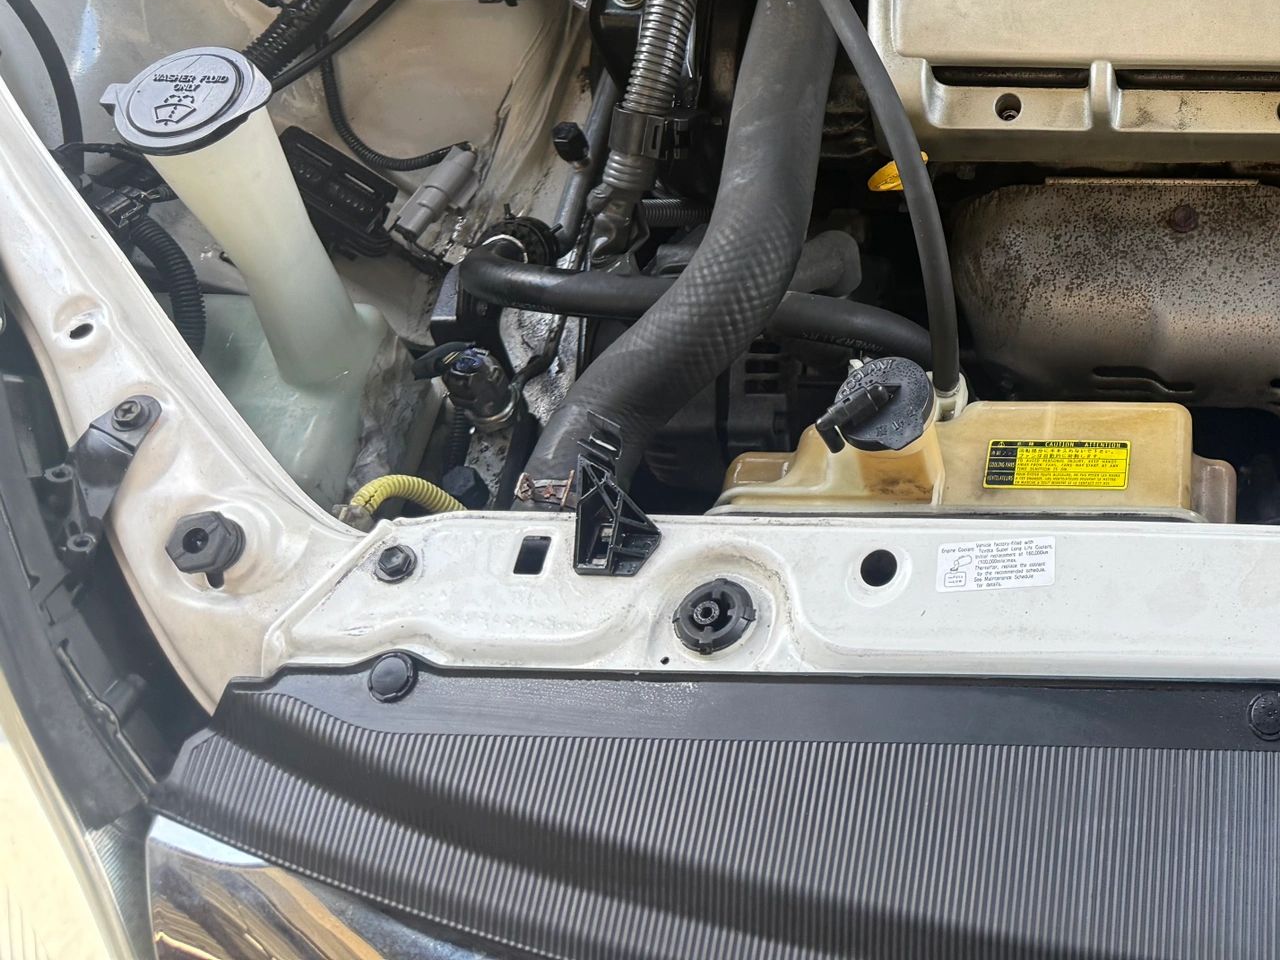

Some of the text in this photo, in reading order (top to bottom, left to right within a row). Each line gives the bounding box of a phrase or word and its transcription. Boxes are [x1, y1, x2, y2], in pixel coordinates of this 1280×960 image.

[153, 74, 229, 83] WASHER FLUID
[173, 83, 201, 92] ONLY
